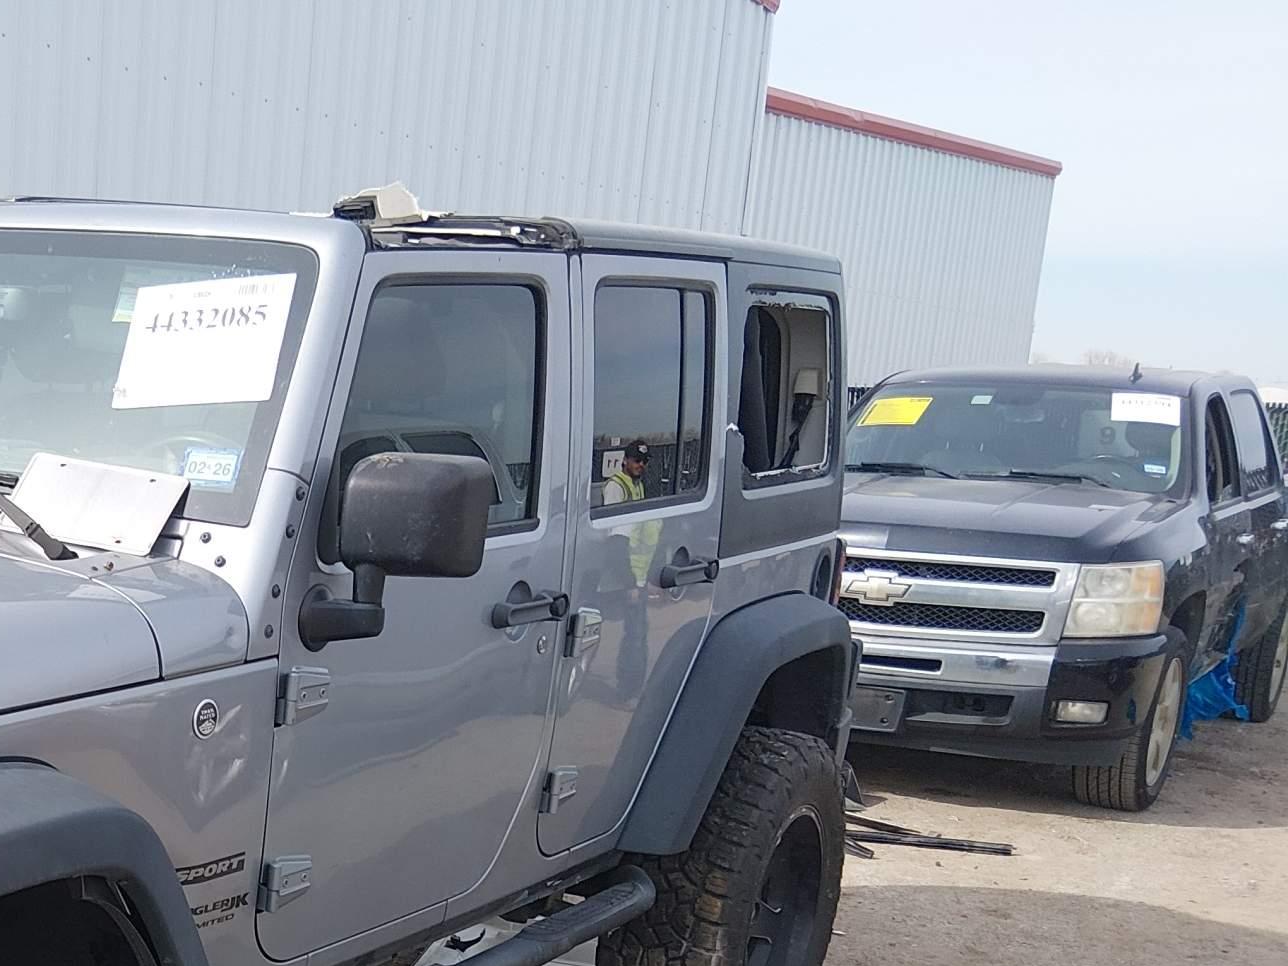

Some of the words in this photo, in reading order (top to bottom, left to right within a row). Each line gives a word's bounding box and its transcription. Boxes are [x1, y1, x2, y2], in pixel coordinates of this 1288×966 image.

[145, 304, 268, 333] 44332085
[176, 857, 245, 881] SPORT
[191, 897, 233, 916] GLER
